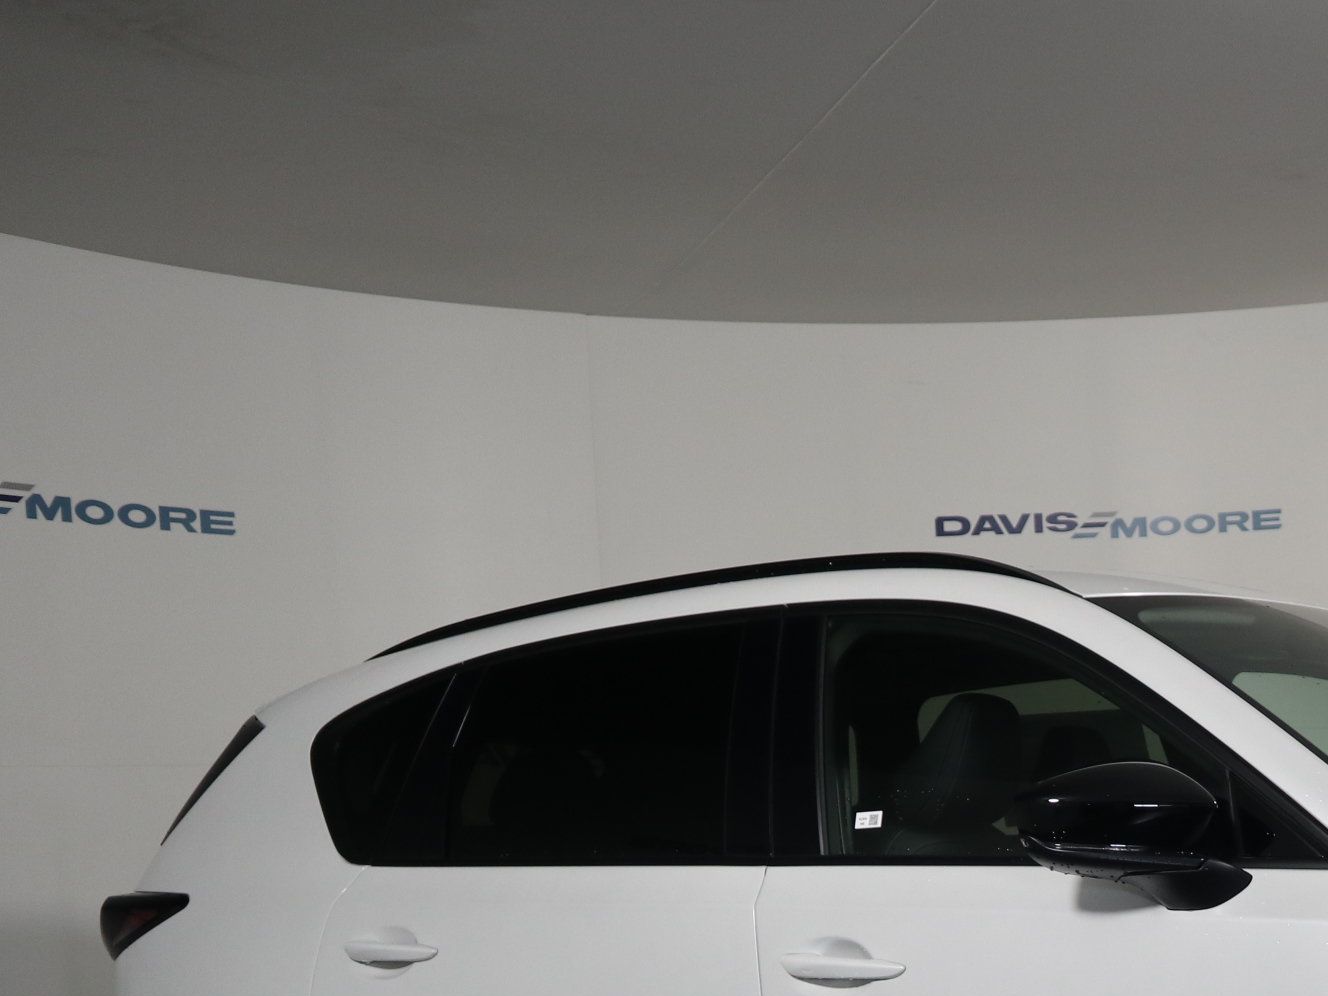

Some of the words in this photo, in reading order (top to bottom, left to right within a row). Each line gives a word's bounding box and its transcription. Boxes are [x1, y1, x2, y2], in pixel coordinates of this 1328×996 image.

[25, 493, 236, 535] MOORE
[935, 511, 1078, 537] DAVIS
[1109, 508, 1283, 539] MOORE
